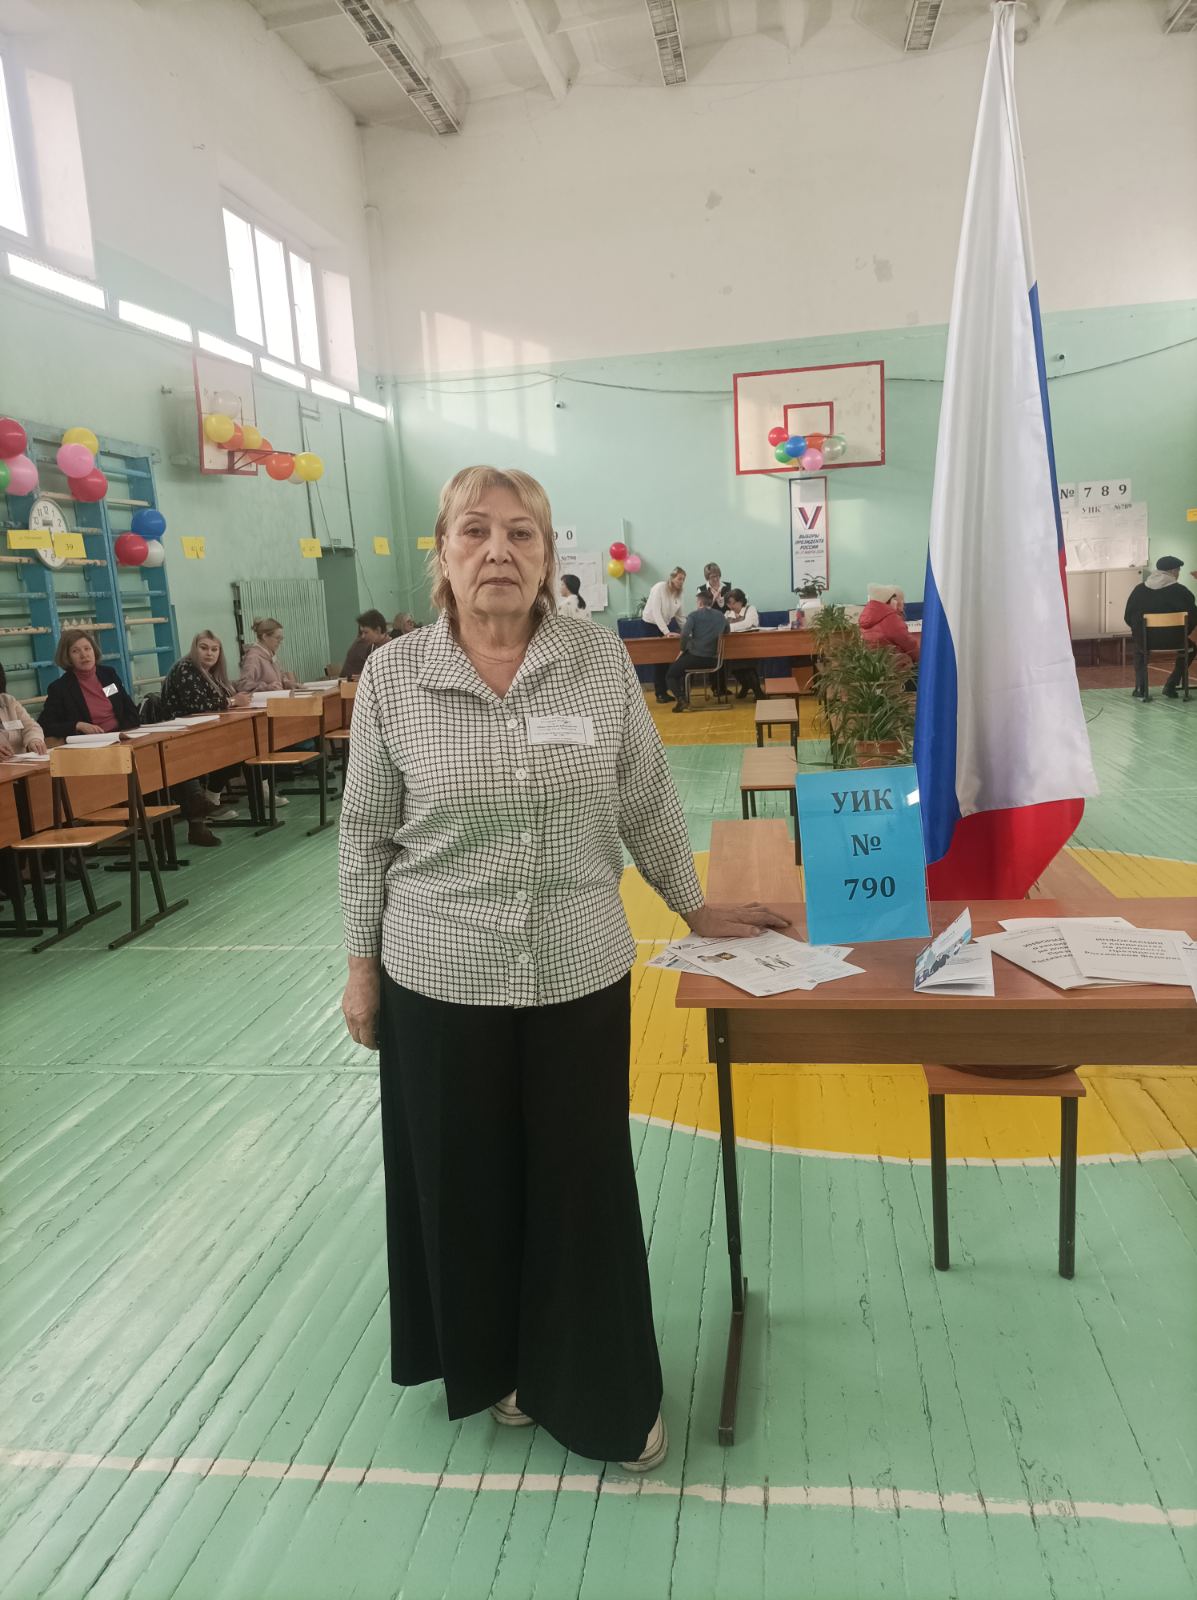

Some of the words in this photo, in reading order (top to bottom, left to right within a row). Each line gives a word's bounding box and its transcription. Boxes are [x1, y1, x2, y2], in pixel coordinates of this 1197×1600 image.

[1060, 488, 1075, 500] №
[831, 788, 893, 814] УИК
[851, 834, 882, 856] №
[844, 876, 896, 901] 790
